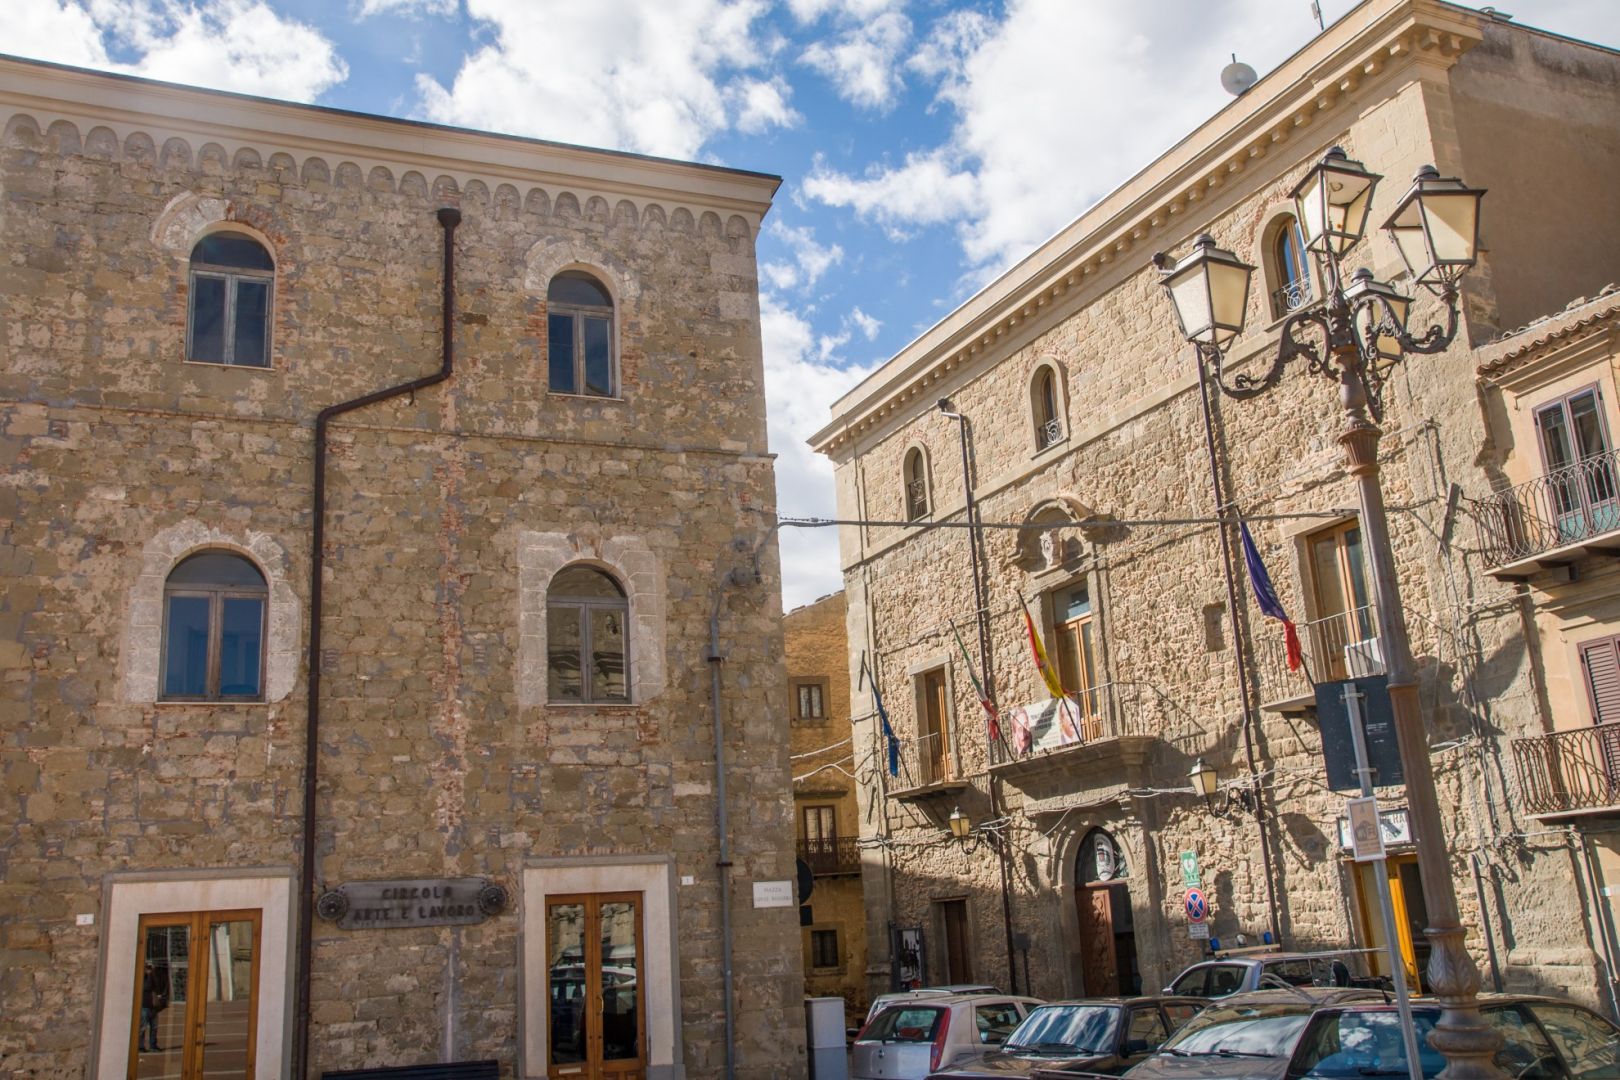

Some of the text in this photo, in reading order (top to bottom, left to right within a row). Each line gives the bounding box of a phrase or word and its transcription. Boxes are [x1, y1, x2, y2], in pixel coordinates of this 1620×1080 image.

[382, 886, 452, 900] CIRCOLO
[353, 904, 475, 920] ARTE E LAVORO
